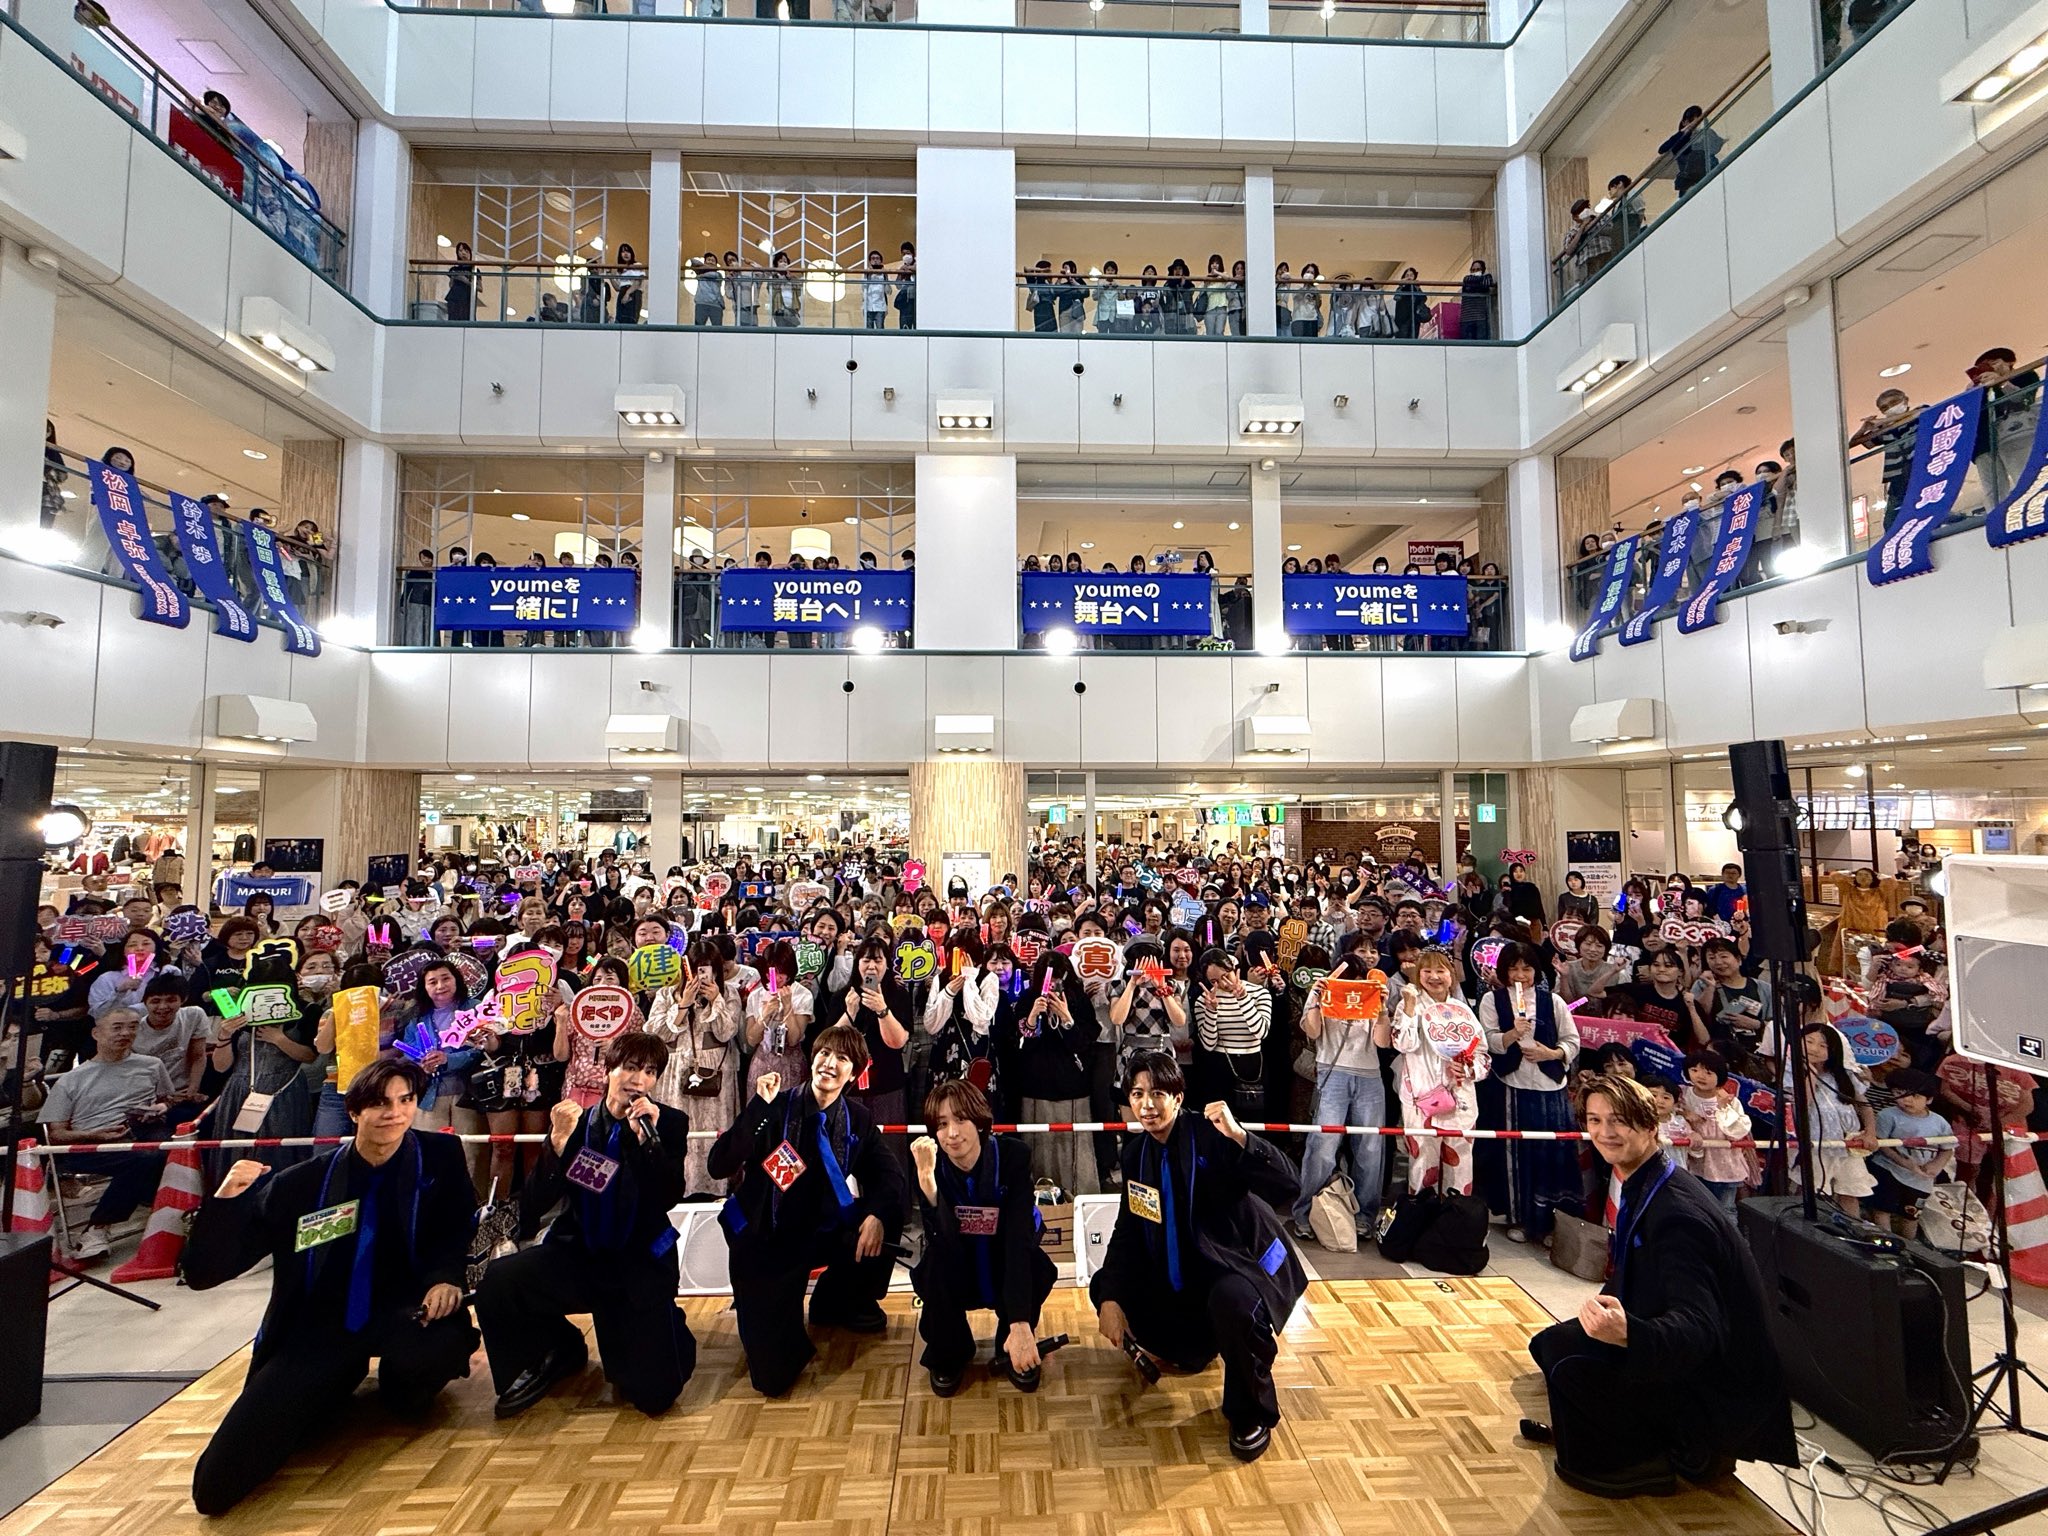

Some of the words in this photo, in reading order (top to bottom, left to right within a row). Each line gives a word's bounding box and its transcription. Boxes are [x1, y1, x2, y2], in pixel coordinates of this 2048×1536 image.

[1927, 405, 1964, 476] 小野寺
[102, 469, 133, 515] 松岡
[181, 499, 207, 540] 鈴木
[1729, 493, 1753, 534] 松岡
[1668, 516, 1690, 553] 鈴木
[252, 527, 274, 565] 柳田
[491, 578, 580, 597] youmeを
[773, 580, 863, 598] youmeの
[1074, 583, 1159, 600] youmeの
[1334, 584, 1418, 602] youmeを
[1502, 850, 1536, 863] たくや
[517, 870, 540, 879] たくや
[843, 862, 862, 879] 渉
[237, 887, 292, 897] MATSURI
[57, 916, 128, 943] 卓弥
[1668, 926, 1717, 940] たくや
[897, 943, 936, 980] わ
[1081, 944, 1112, 977] 真
[1344, 990, 1364, 1010] 真
[581, 1006, 624, 1021] たくや
[1428, 1022, 1475, 1042] たくや
[766, 1154, 795, 1186] たくや
[303, 1209, 338, 1224] MATSURI
[960, 1217, 997, 1233] つばさ
[300, 1216, 353, 1246] ゆうき
